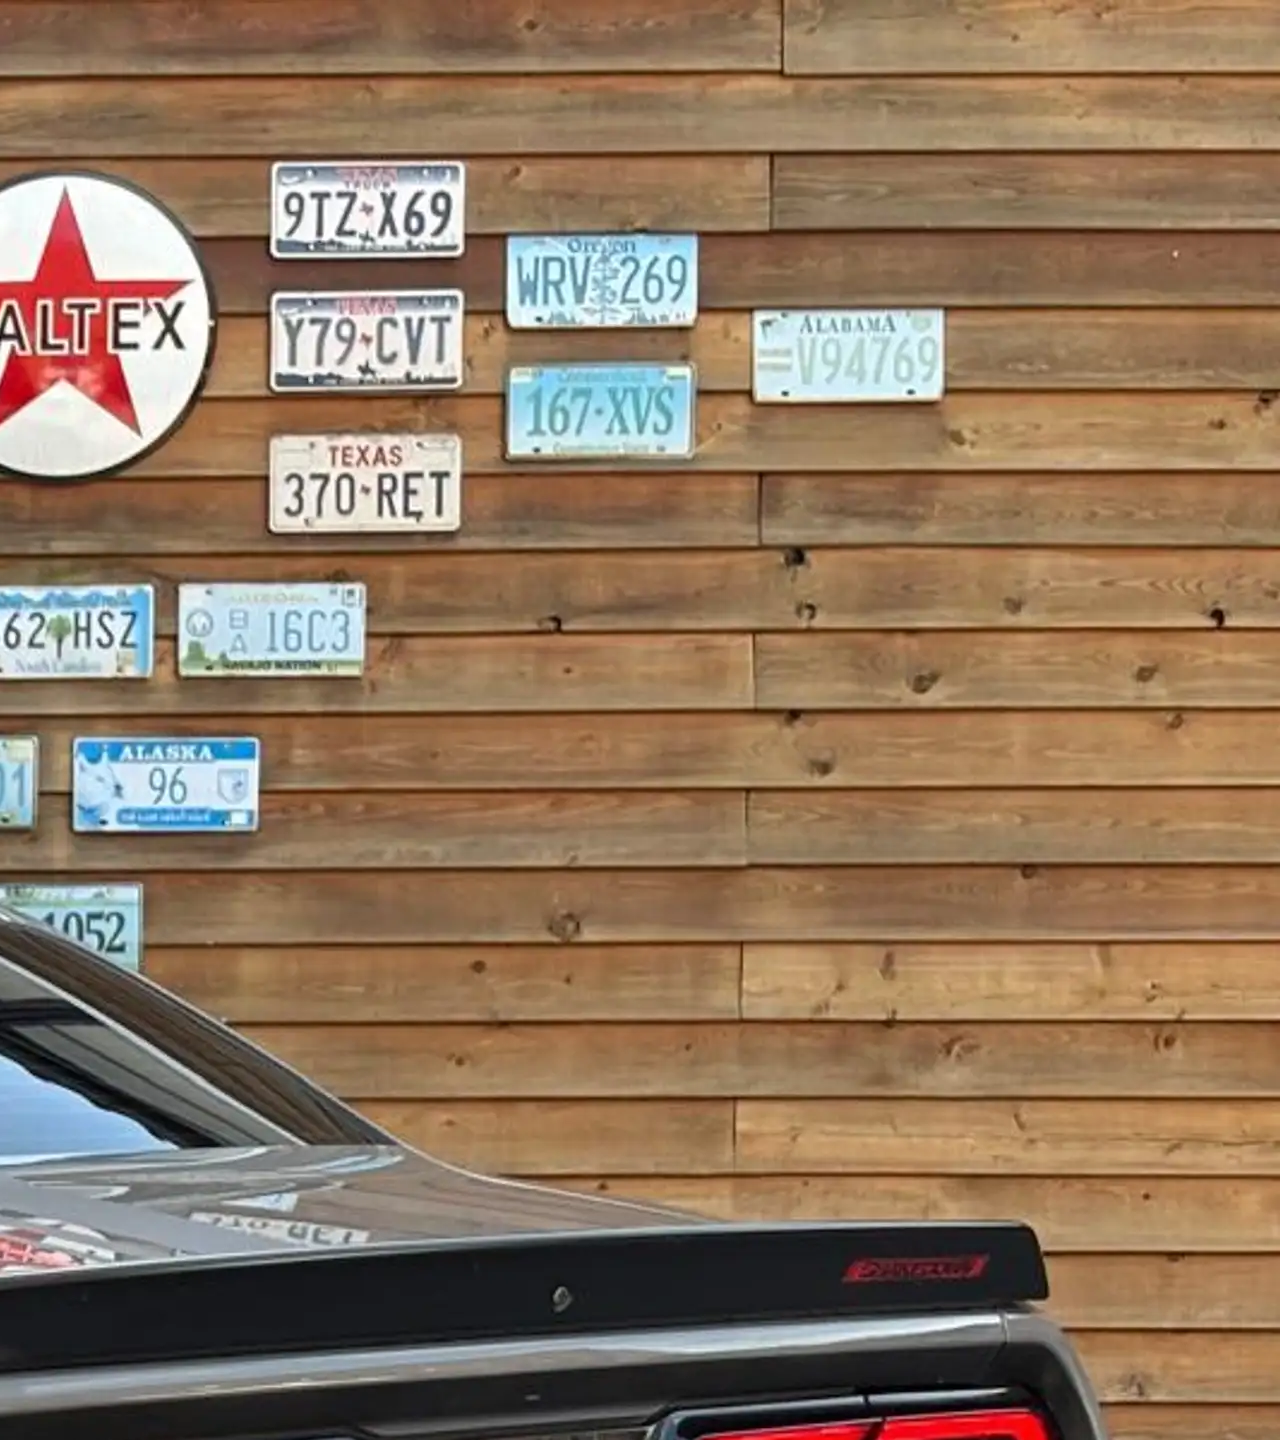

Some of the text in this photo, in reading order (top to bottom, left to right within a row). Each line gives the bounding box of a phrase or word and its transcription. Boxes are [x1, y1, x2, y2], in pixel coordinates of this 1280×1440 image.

[283, 190, 452, 237] 9TZ X69
[517, 254, 687, 306] WRV 269
[282, 315, 451, 366] Y79 CVT
[800, 315, 896, 333] ALABAMA
[797, 336, 938, 385] V94769
[329, 445, 403, 467] TEXAS
[284, 471, 451, 518] 370 RET
[73, 610, 138, 649] HSZ
[266, 609, 349, 653] 16C3
[120, 745, 214, 762] ALASKA
[149, 767, 188, 805] 96
